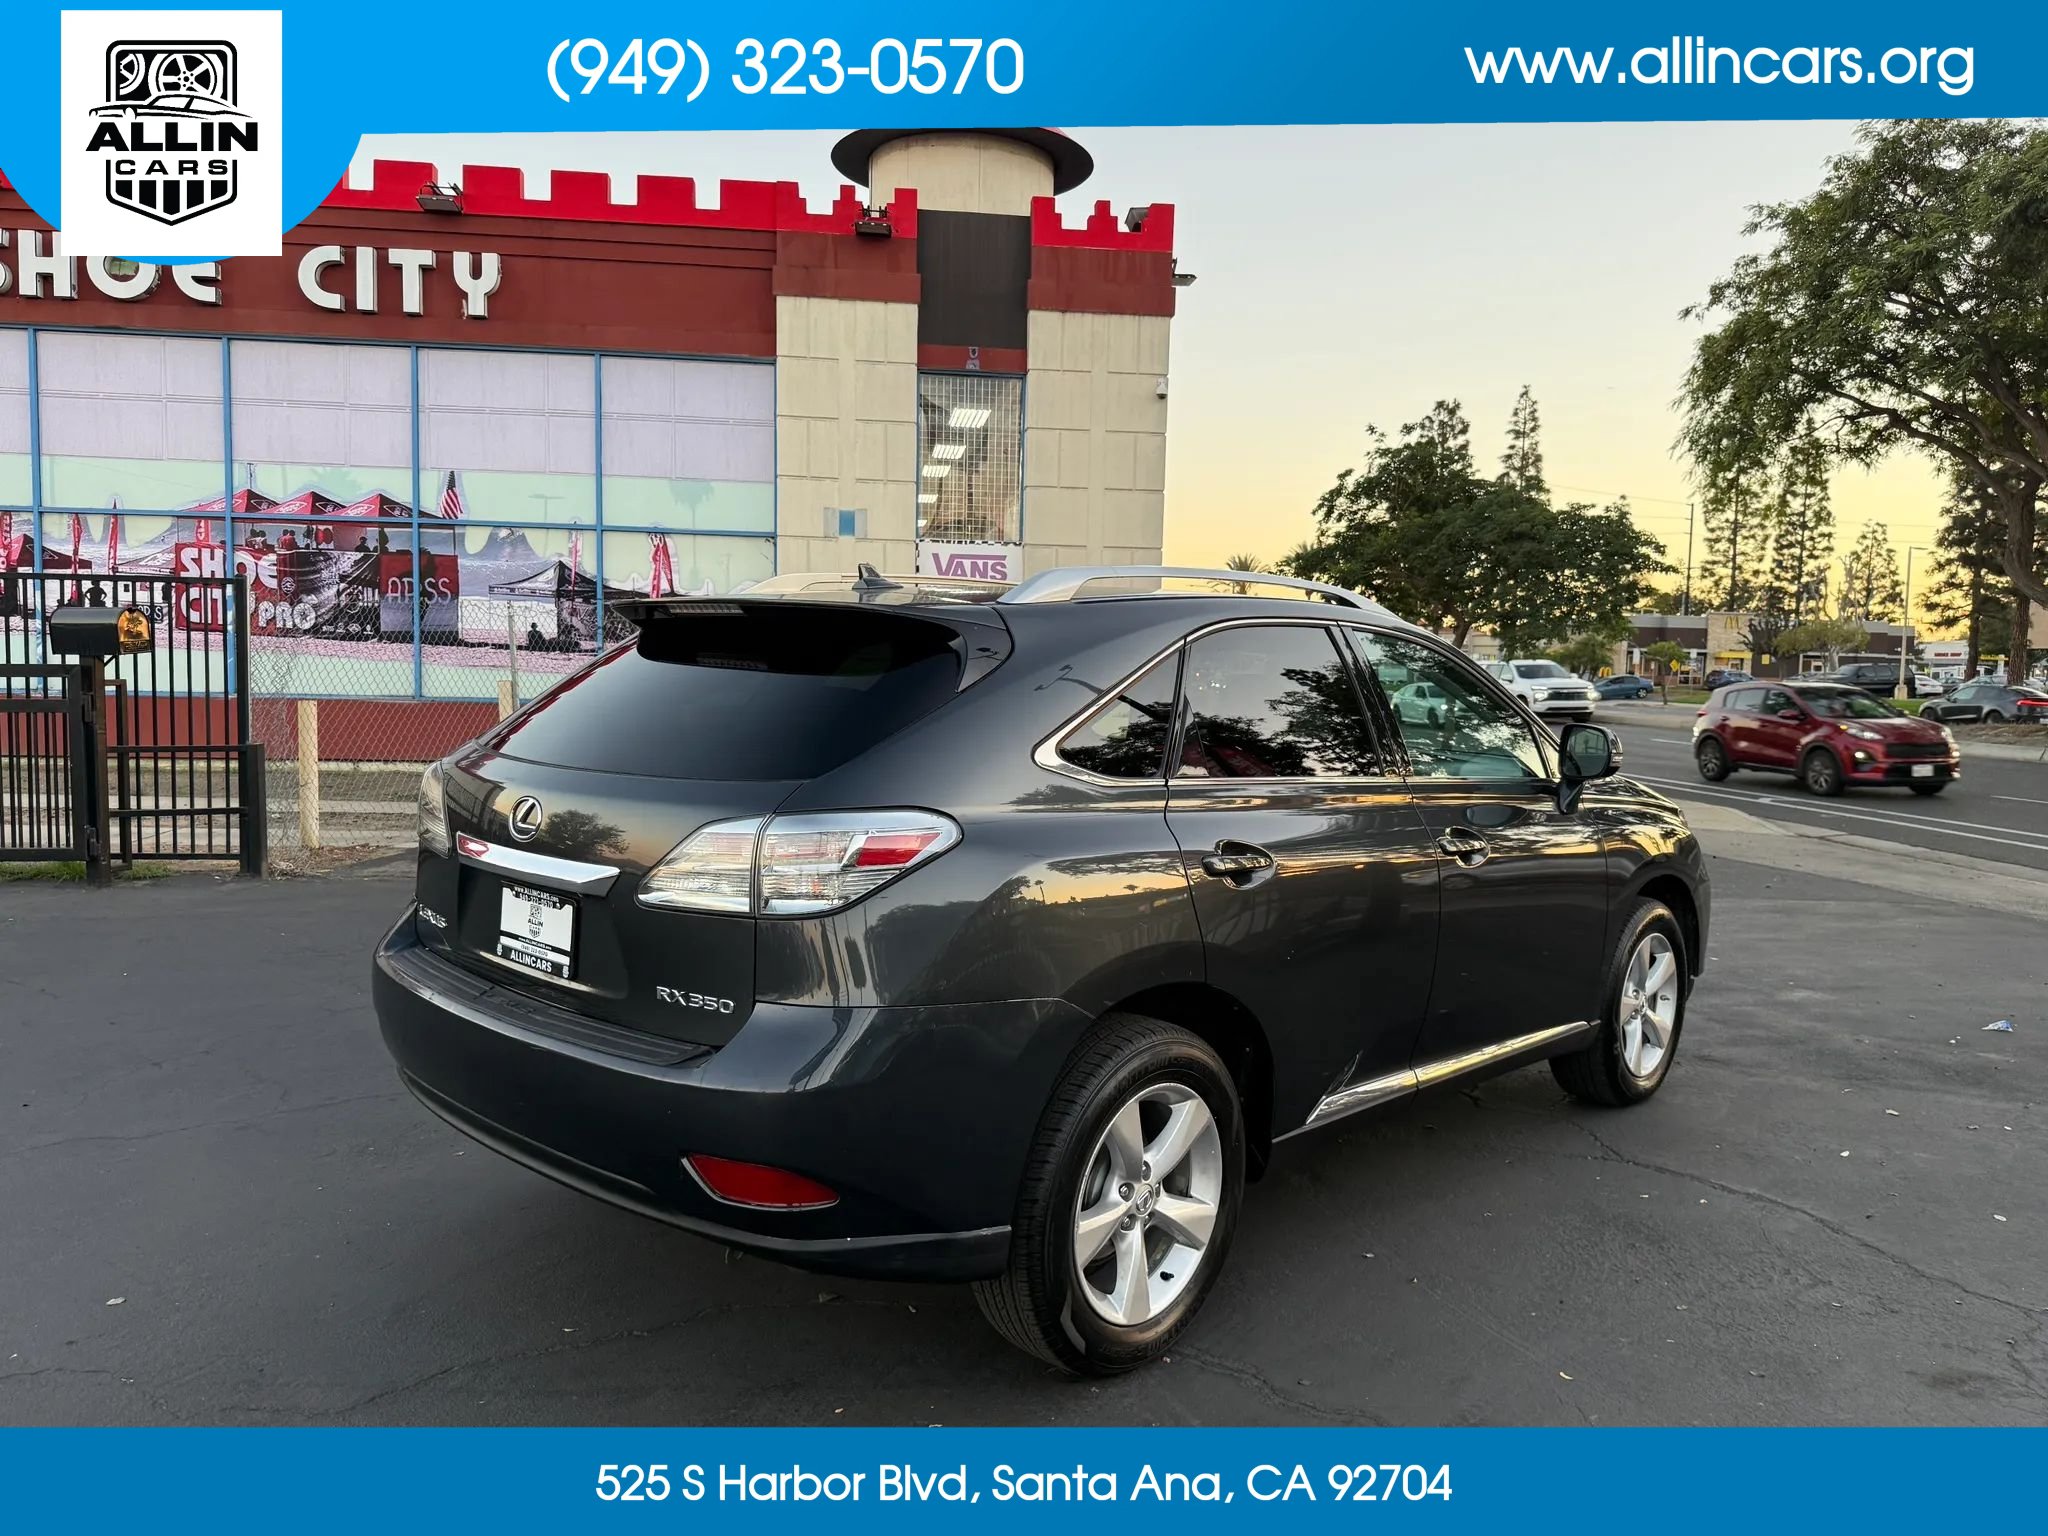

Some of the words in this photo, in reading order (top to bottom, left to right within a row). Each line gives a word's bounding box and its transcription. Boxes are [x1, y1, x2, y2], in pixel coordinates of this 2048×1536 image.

[0, 228, 222, 305] HOE
[298, 245, 502, 318] CITY
[931, 552, 1008, 581] VANS
[258, 600, 316, 630] PRO
[510, 949, 552, 973] ALLINCARS
